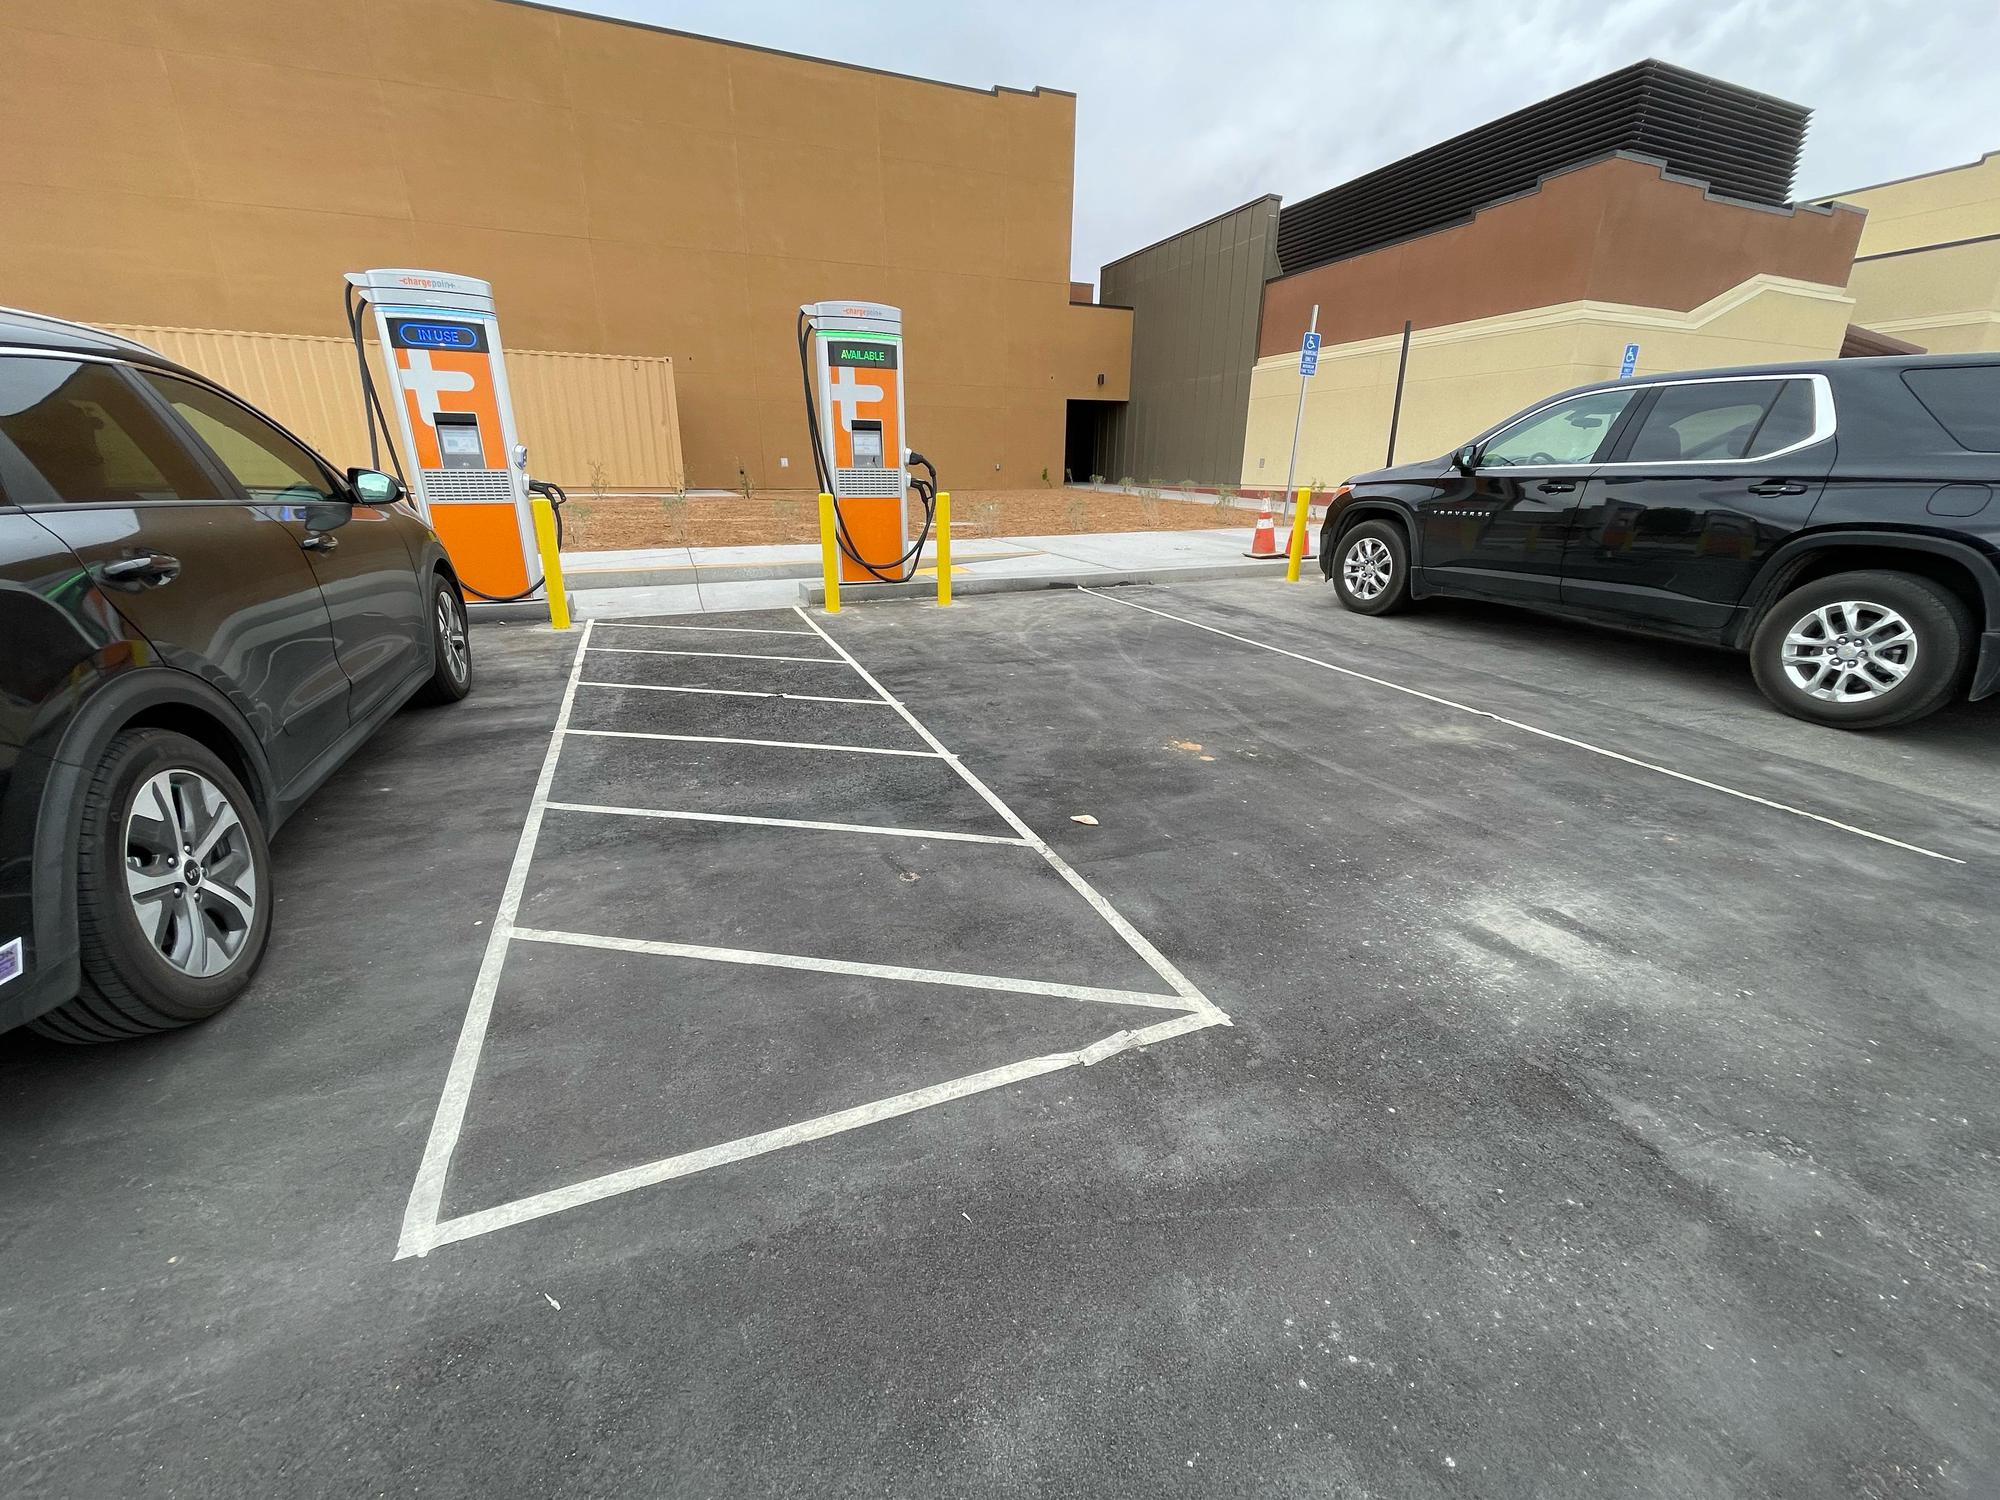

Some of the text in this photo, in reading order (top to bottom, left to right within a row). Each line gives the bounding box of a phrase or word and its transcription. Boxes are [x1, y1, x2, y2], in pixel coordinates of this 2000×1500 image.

[417, 329, 459, 342] IN USE
[841, 349, 885, 361] AVAILABLE
